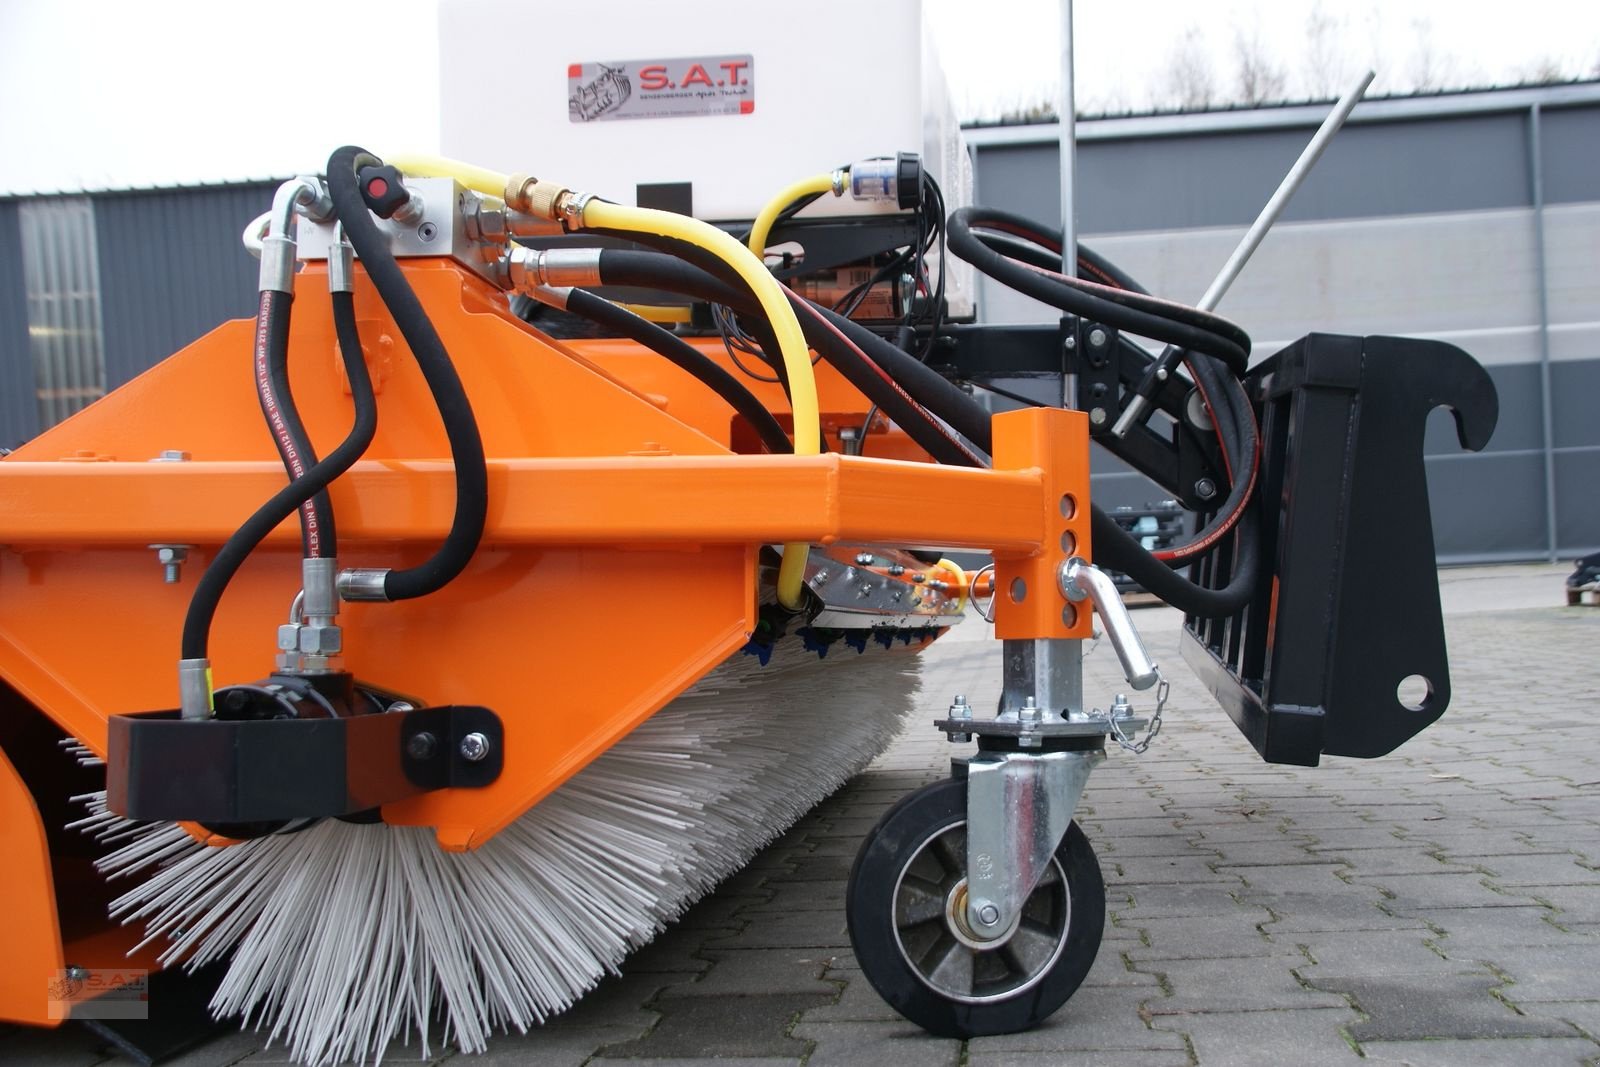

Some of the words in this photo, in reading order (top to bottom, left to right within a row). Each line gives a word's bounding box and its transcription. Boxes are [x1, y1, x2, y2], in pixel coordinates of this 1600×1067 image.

[639, 61, 748, 91] S.A.T.
[258, 345, 265, 359] WP
[271, 412, 285, 430] SAE
[281, 435, 297, 459] DN12
[307, 511, 317, 529] DIN
